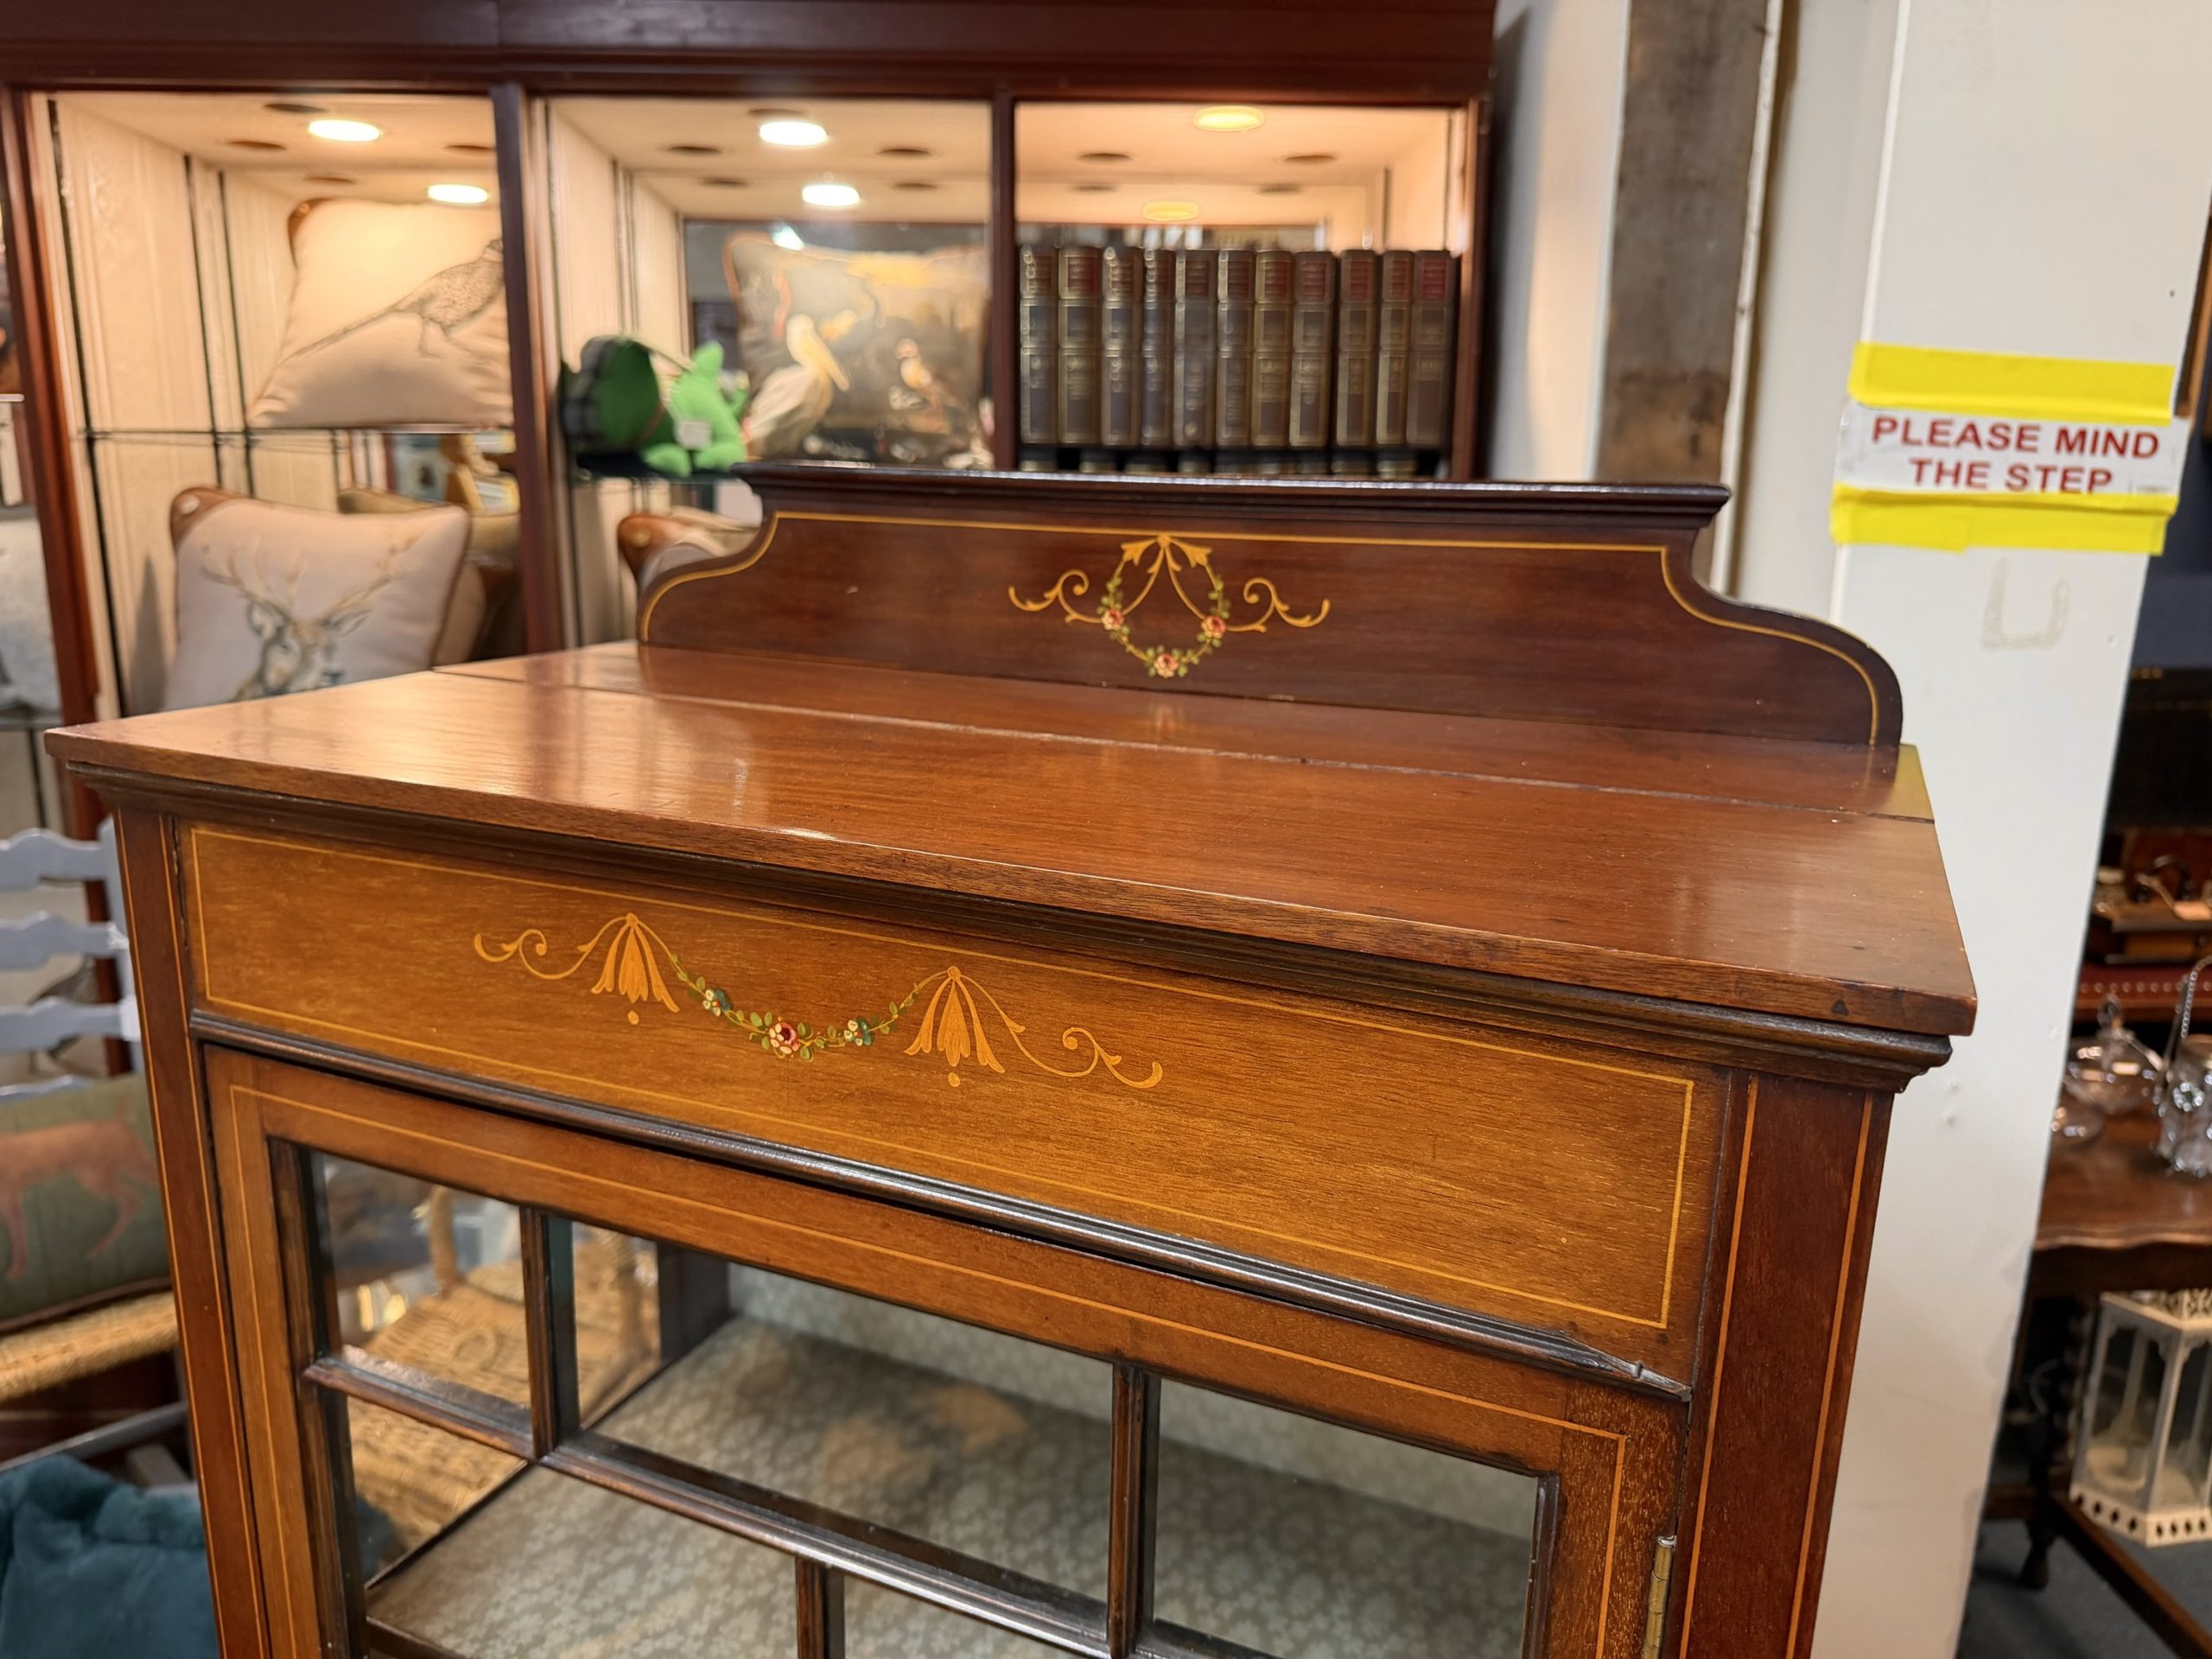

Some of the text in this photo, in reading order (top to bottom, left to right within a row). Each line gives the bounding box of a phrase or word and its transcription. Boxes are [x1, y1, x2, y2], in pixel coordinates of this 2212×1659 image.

[1872, 416, 2159, 460] PLEASE MIND
[1909, 459, 2113, 493] THE STEP
